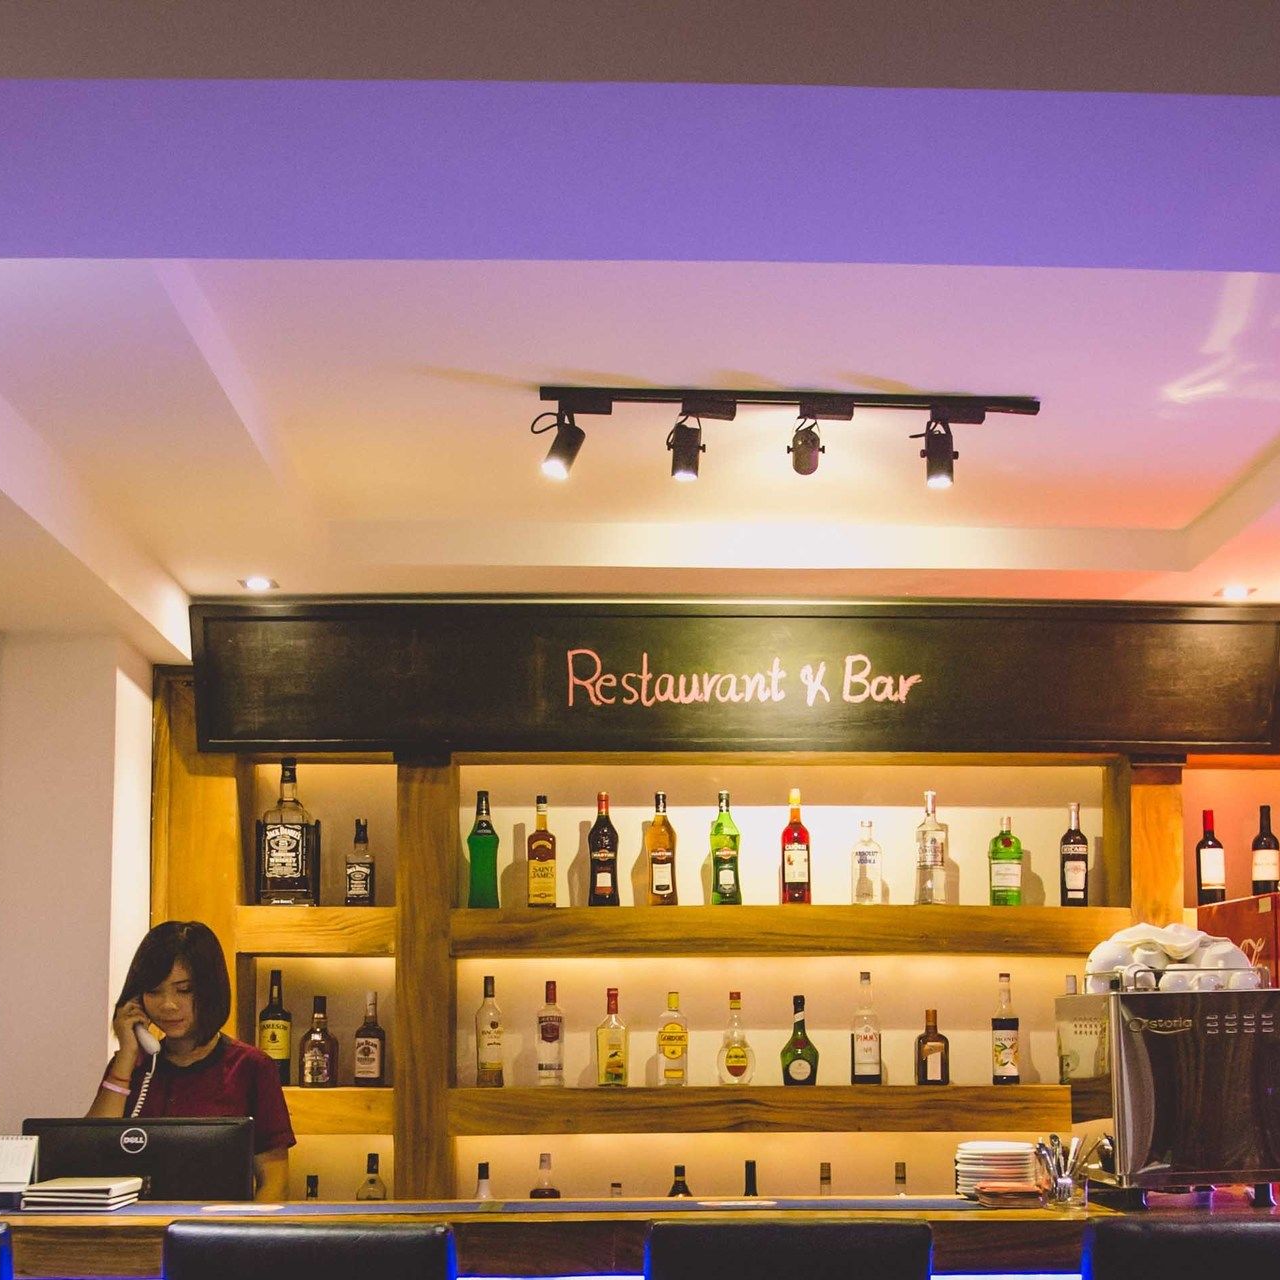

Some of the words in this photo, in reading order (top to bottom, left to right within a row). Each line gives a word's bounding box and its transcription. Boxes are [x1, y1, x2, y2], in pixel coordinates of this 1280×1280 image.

[568, 648, 787, 707] Restaurant
[842, 653, 923, 704] Bar
[123, 1136, 145, 1144] DELL
